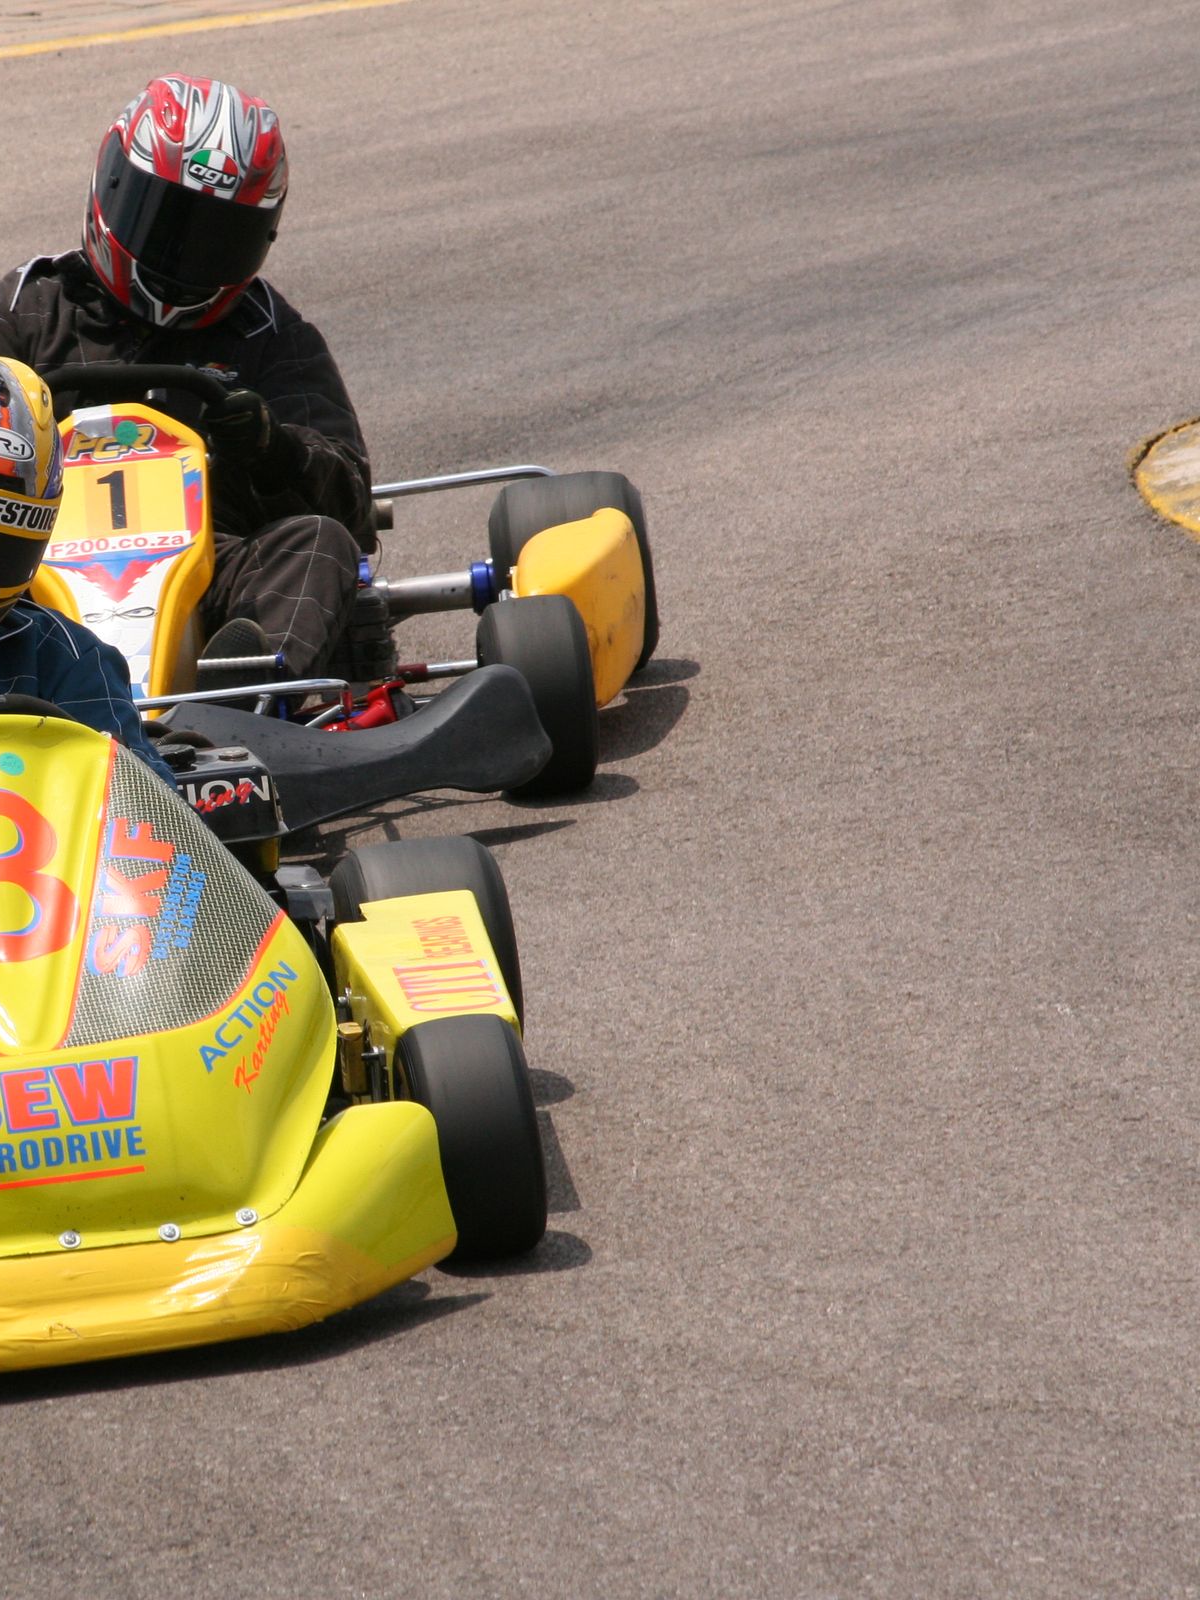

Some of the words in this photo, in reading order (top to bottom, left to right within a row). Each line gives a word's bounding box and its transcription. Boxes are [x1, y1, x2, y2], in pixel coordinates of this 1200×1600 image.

[189, 163, 236, 185] agv
[97, 470, 127, 530] 1
[49, 534, 185, 558] F200.co.za
[176, 775, 271, 807] ION
[86, 817, 175, 978] SKF
[199, 961, 298, 1074] ACTION
[234, 989, 290, 1096] Karting
